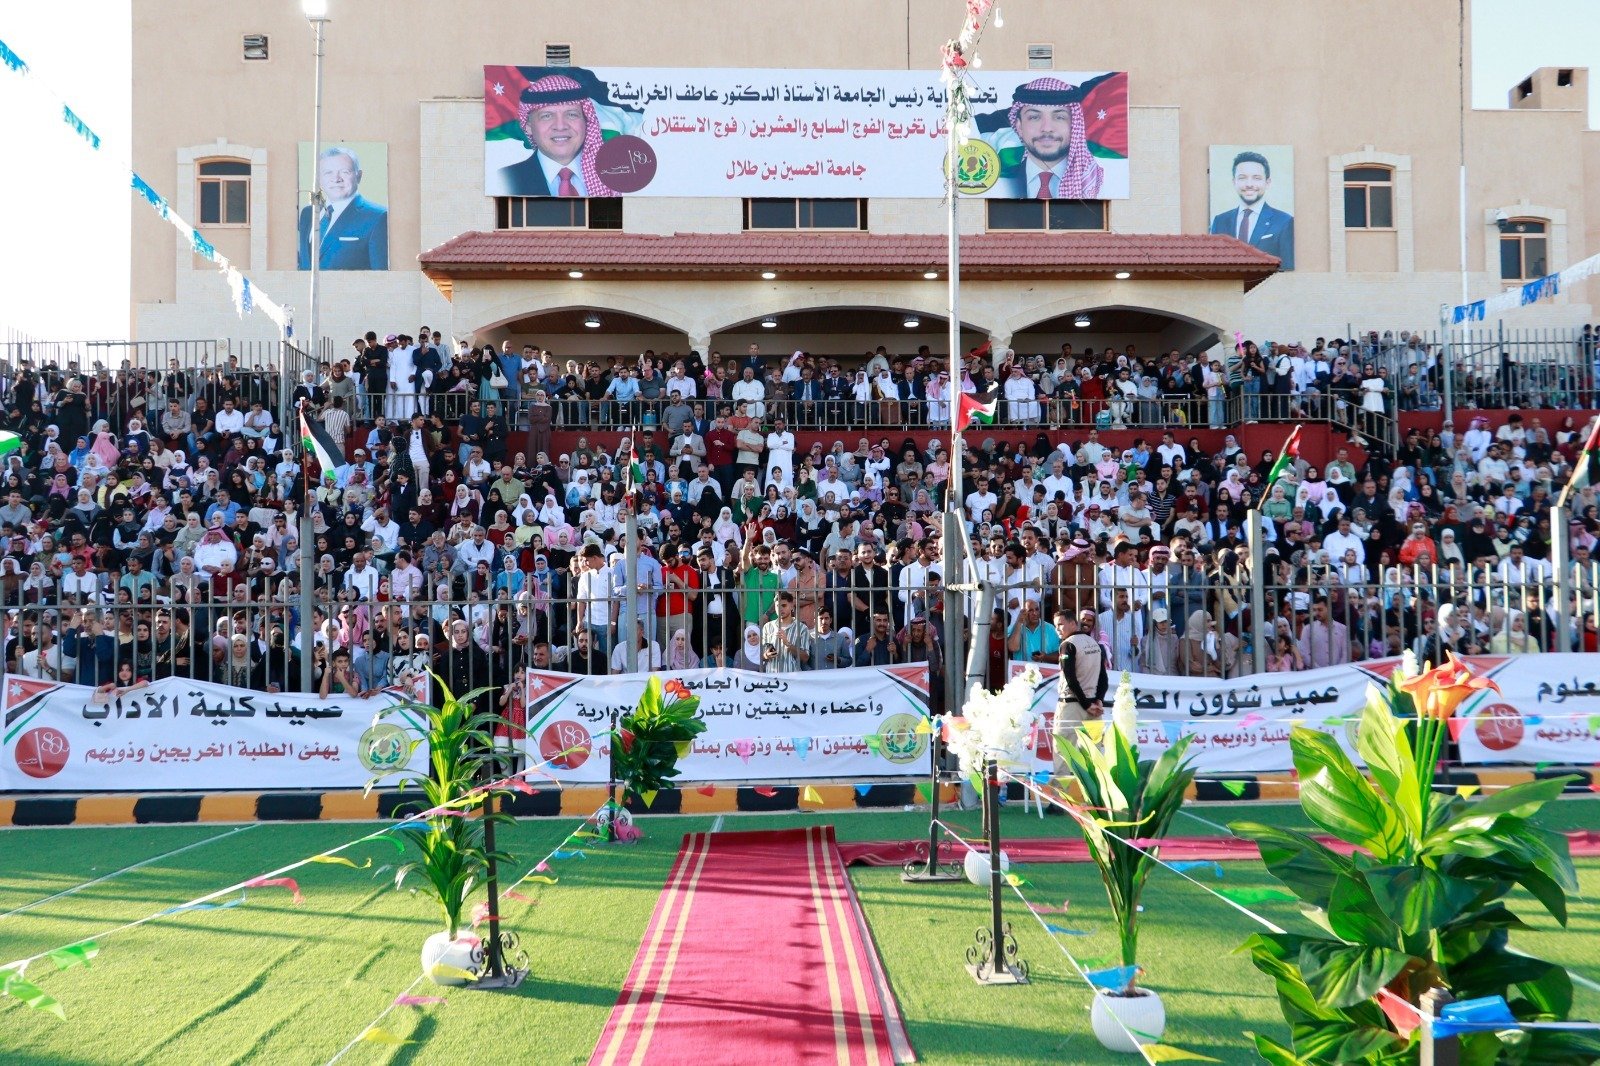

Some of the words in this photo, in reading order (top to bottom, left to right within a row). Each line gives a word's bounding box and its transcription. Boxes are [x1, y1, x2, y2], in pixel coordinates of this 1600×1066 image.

[611, 81, 672, 110] الخرابشة
[675, 85, 719, 101] عاطف
[722, 85, 779, 106] الدكتور
[783, 81, 830, 102] الأستاذ
[833, 86, 885, 107] الجامعة
[889, 86, 924, 108] رئيس
[650, 116, 711, 137] الاستقلال
[749, 115, 808, 138] والعشرين
[811, 118, 849, 139] السابع
[852, 117, 885, 139] الفوج
[887, 117, 926, 139] تخريج
[726, 160, 759, 180] طلال
[761, 161, 778, 180] بن
[781, 160, 824, 181] الحسين
[827, 159, 867, 180] جامعة
[743, 676, 788, 693] رئيس
[82, 692, 179, 727] الآداب
[188, 691, 257, 727] كلية
[745, 701, 815, 720] الهيئتين
[820, 696, 884, 716] وأعضاء
[1189, 684, 1263, 717] شؤون
[1270, 686, 1340, 714] عميد
[265, 701, 344, 726] عميد
[775, 736, 819, 756] البة
[1210, 727, 1257, 749] وذويهم
[85, 741, 146, 764] وذويهم
[150, 742, 232, 763] الخريجين
[237, 740, 294, 762] الطلبة
[298, 741, 341, 762] يهنئ
